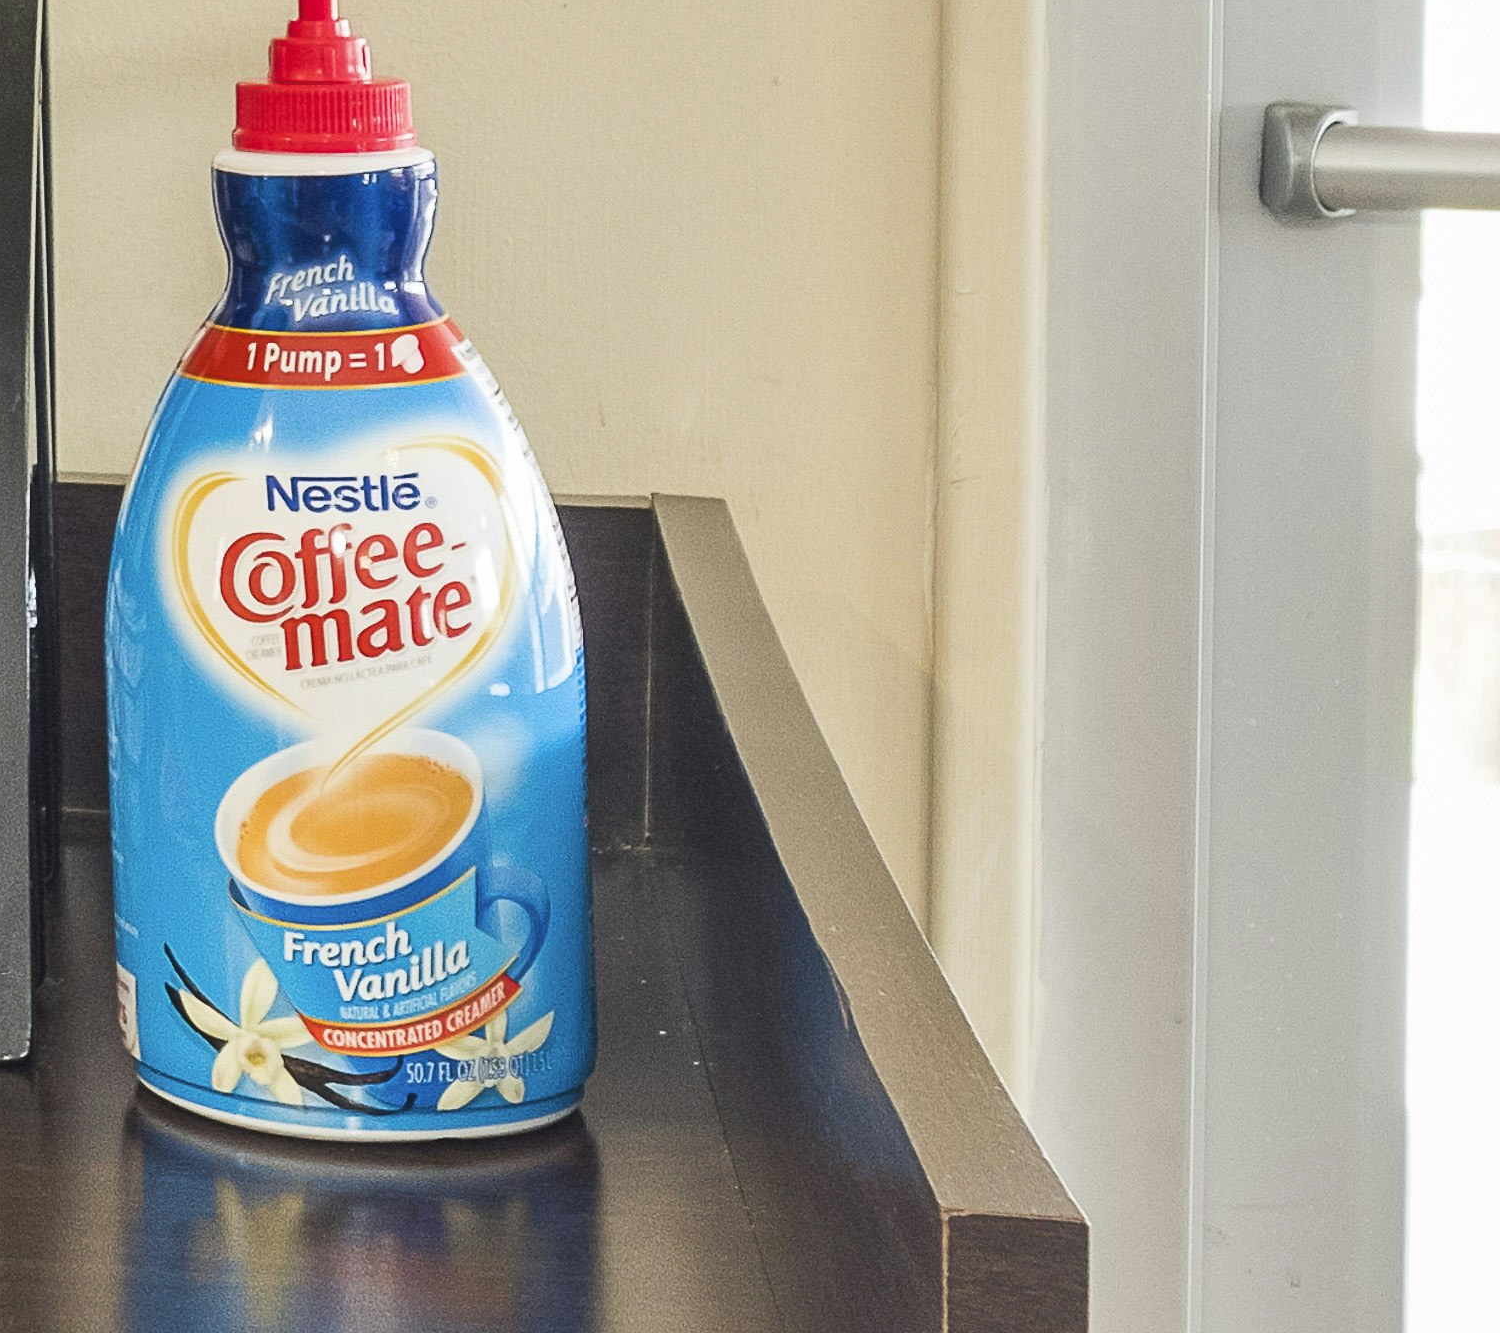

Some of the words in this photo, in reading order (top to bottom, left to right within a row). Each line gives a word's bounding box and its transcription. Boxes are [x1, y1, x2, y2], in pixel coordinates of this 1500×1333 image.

[264, 253, 355, 305] French
[293, 281, 399, 322] Vanilla
[247, 342, 257, 371] 1
[263, 342, 342, 382] Pump
[374, 342, 385, 371] 1
[280, 579, 473, 672] mate
[283, 921, 413, 967] French
[332, 939, 470, 1002] Vanilla
[323, 1019, 443, 1048] CONCENTRATED
[446, 981, 506, 1036] CREAMER
[340, 1006, 380, 1020] NATURAL
[406, 1060, 434, 1084] 50.7
[438, 1061, 453, 1083] FL
[457, 1059, 475, 1081] OZ
